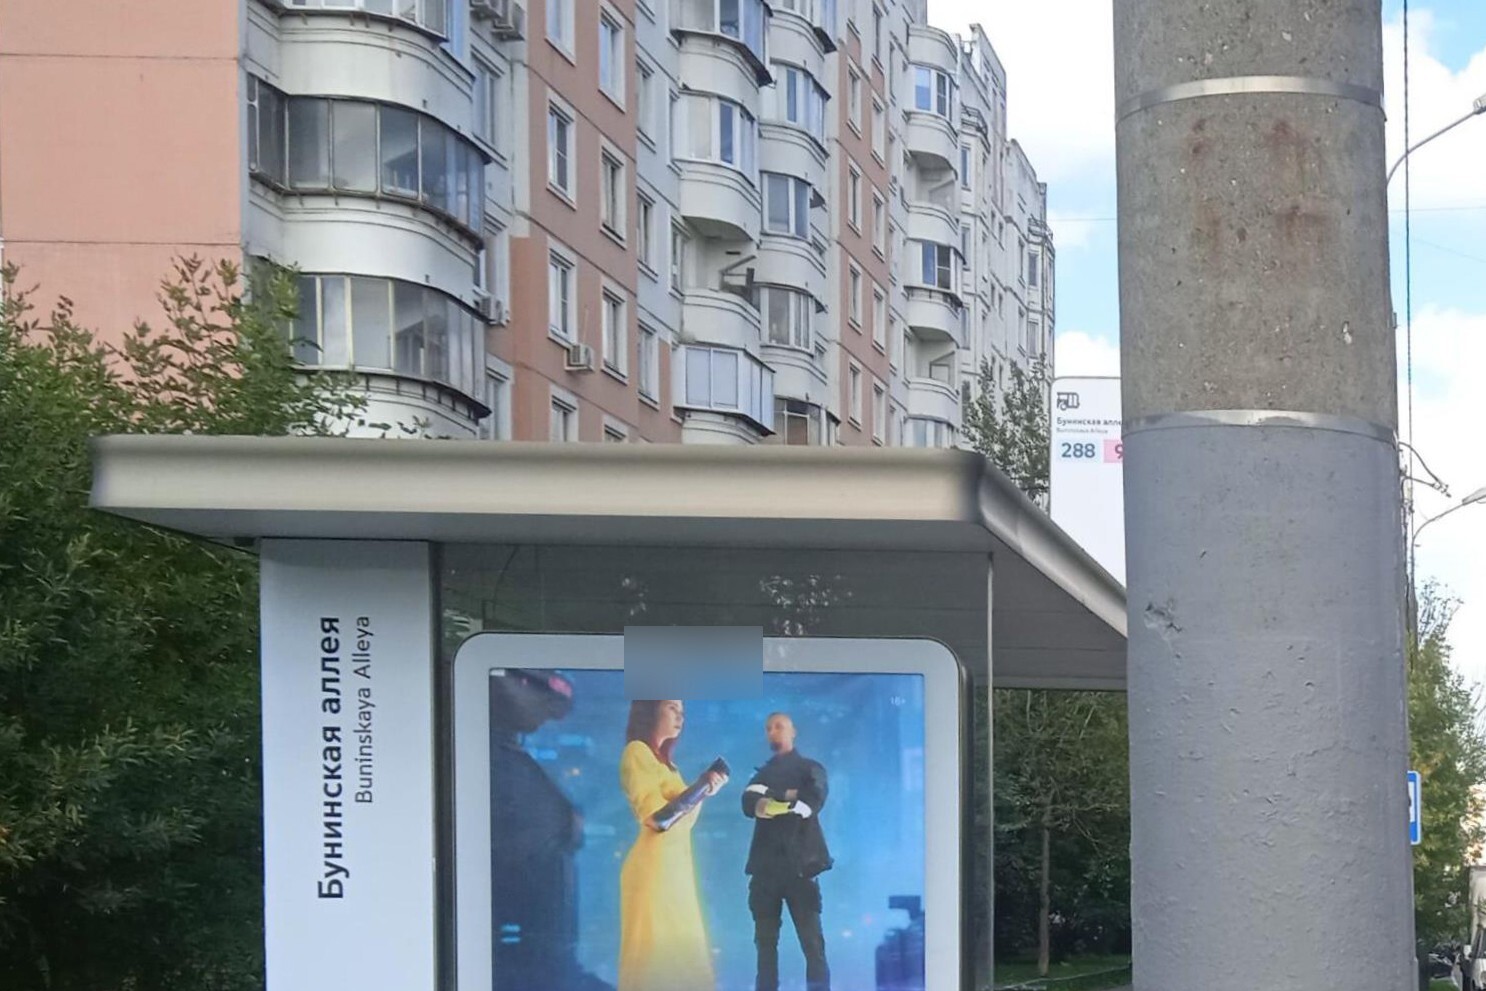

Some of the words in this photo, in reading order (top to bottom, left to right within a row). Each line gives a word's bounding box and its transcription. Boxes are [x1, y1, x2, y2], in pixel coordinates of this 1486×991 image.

[1061, 442, 1096, 459] 288
[1114, 443, 1124, 460] 9
[320, 616, 341, 714] аллея
[351, 615, 375, 679] Alleya
[352, 687, 376, 803] Buninskaya
[317, 725, 350, 899] Бунинская
